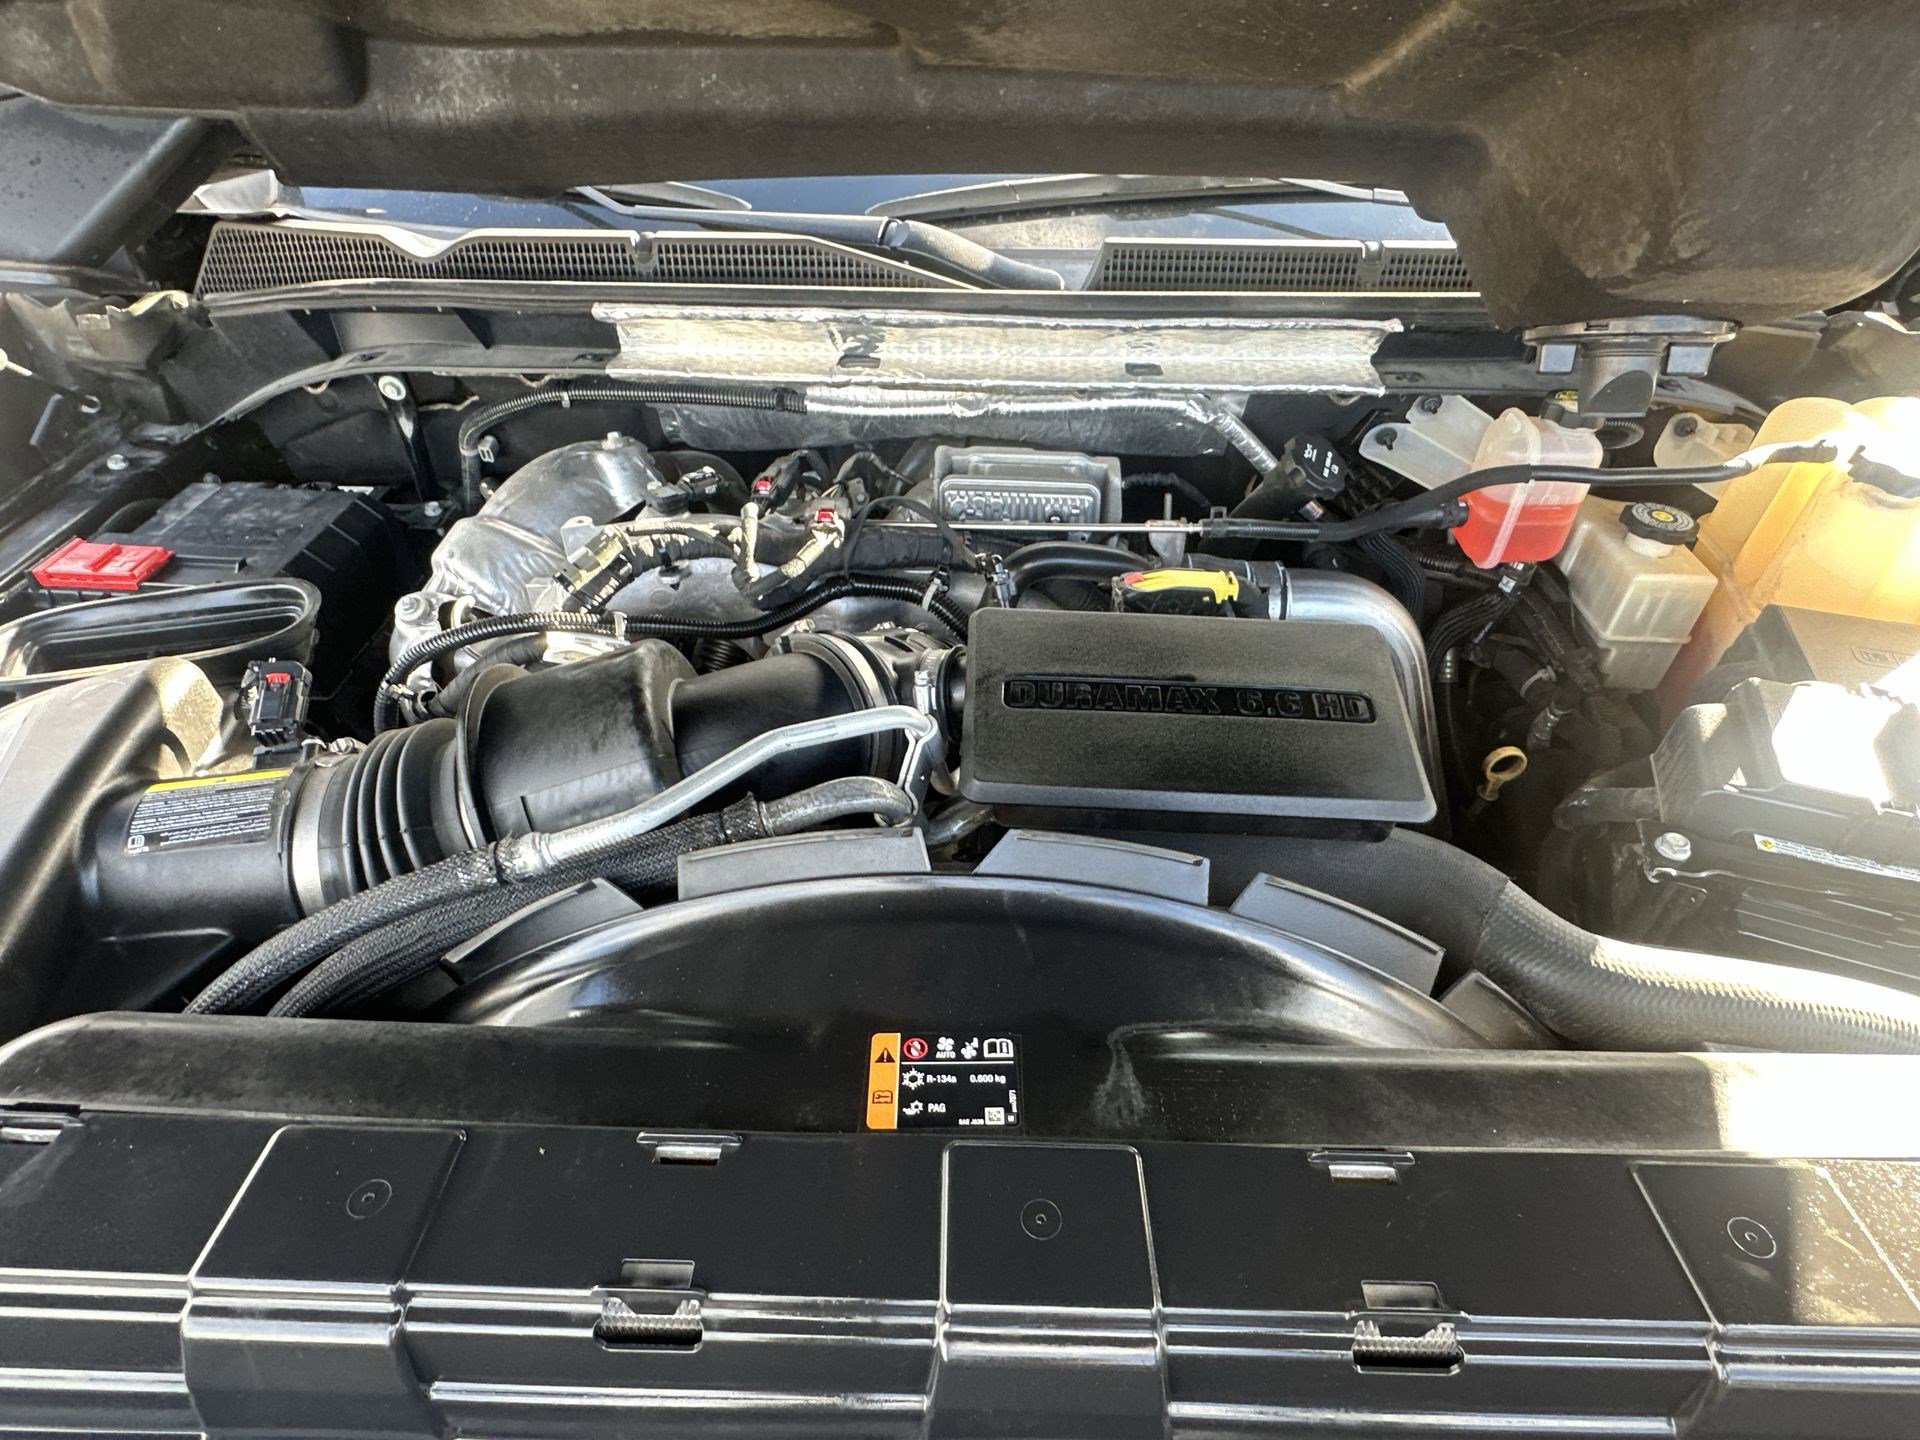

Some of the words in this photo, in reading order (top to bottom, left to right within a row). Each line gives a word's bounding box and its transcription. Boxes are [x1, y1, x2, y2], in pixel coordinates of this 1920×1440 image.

[1009, 680, 1222, 714] DURAMAX
[1235, 691, 1303, 717] 6.6
[1313, 693, 1374, 720] HD
[935, 1050, 956, 1059] AUTO
[926, 1074, 957, 1083] R-134a
[994, 1074, 1007, 1084] kg
[927, 1103, 946, 1113] PAG
